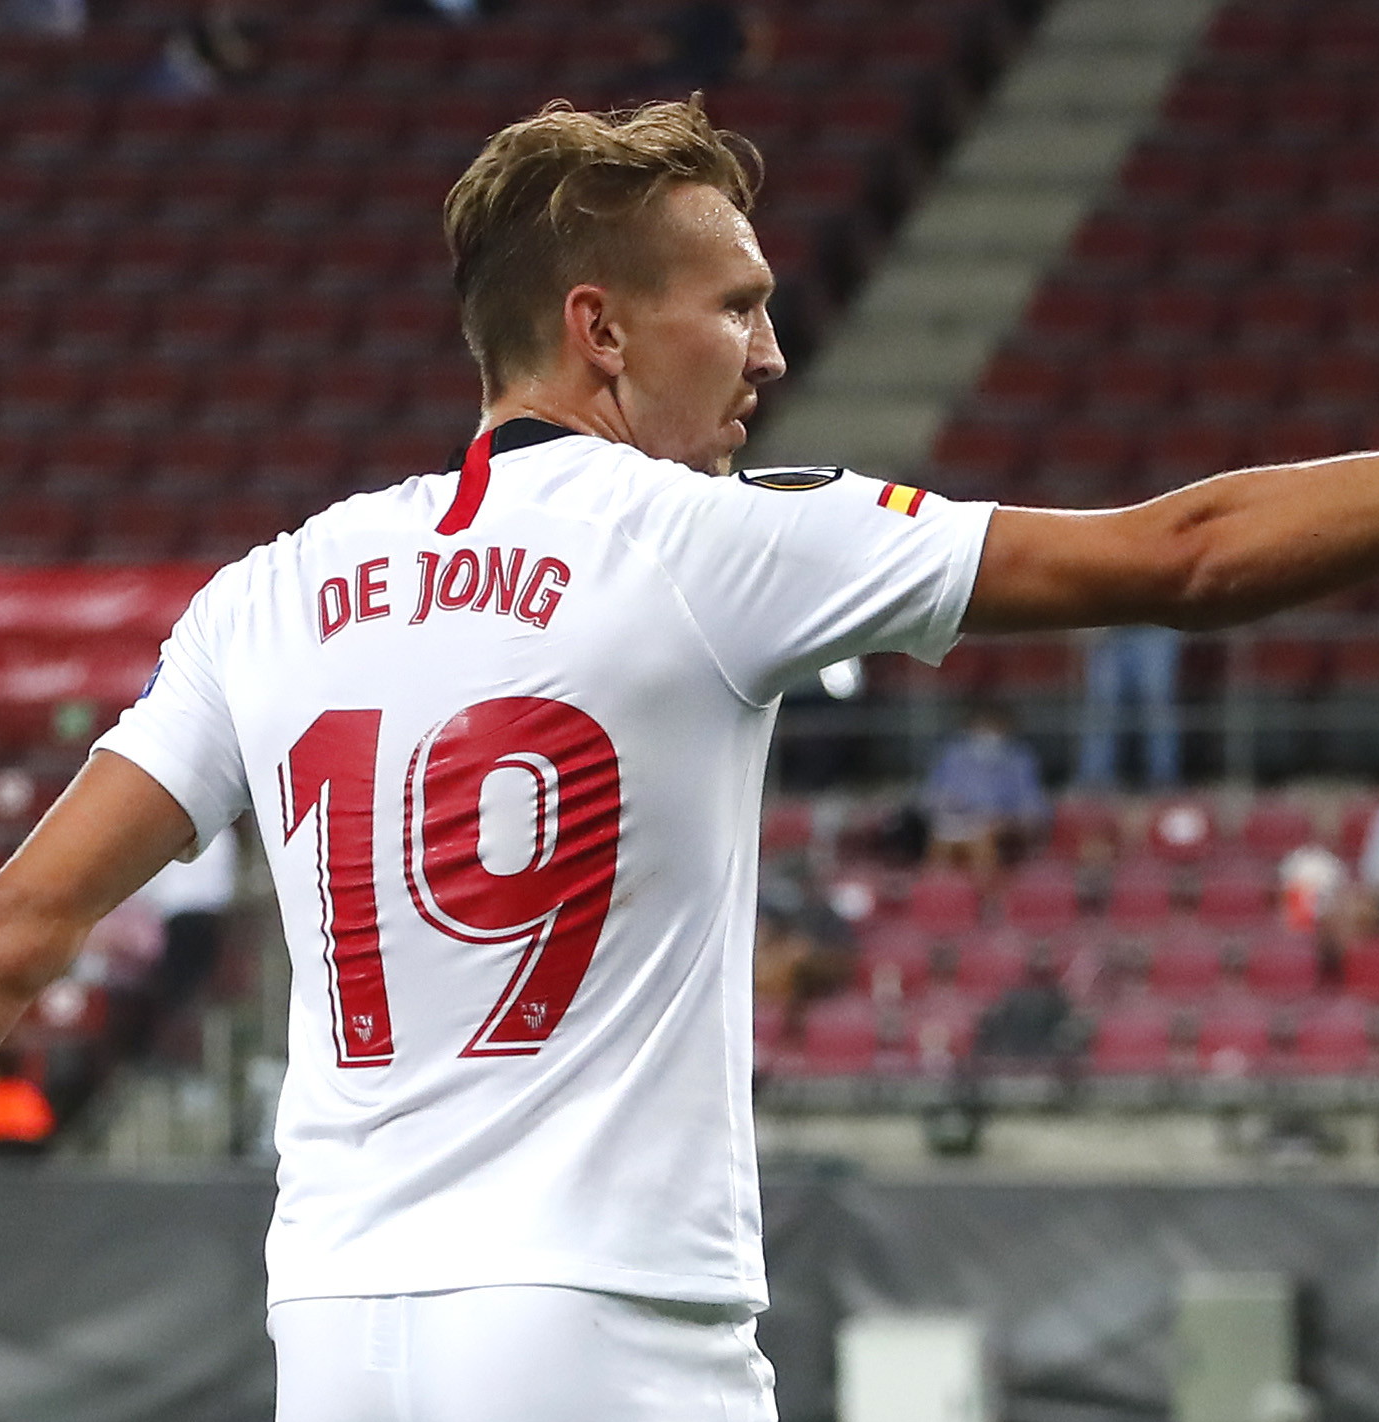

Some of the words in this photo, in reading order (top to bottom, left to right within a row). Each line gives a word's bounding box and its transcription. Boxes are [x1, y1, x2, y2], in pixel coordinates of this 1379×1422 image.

[318, 556, 390, 645] DE
[408, 546, 571, 630] JONG
[277, 695, 622, 1069] 19
